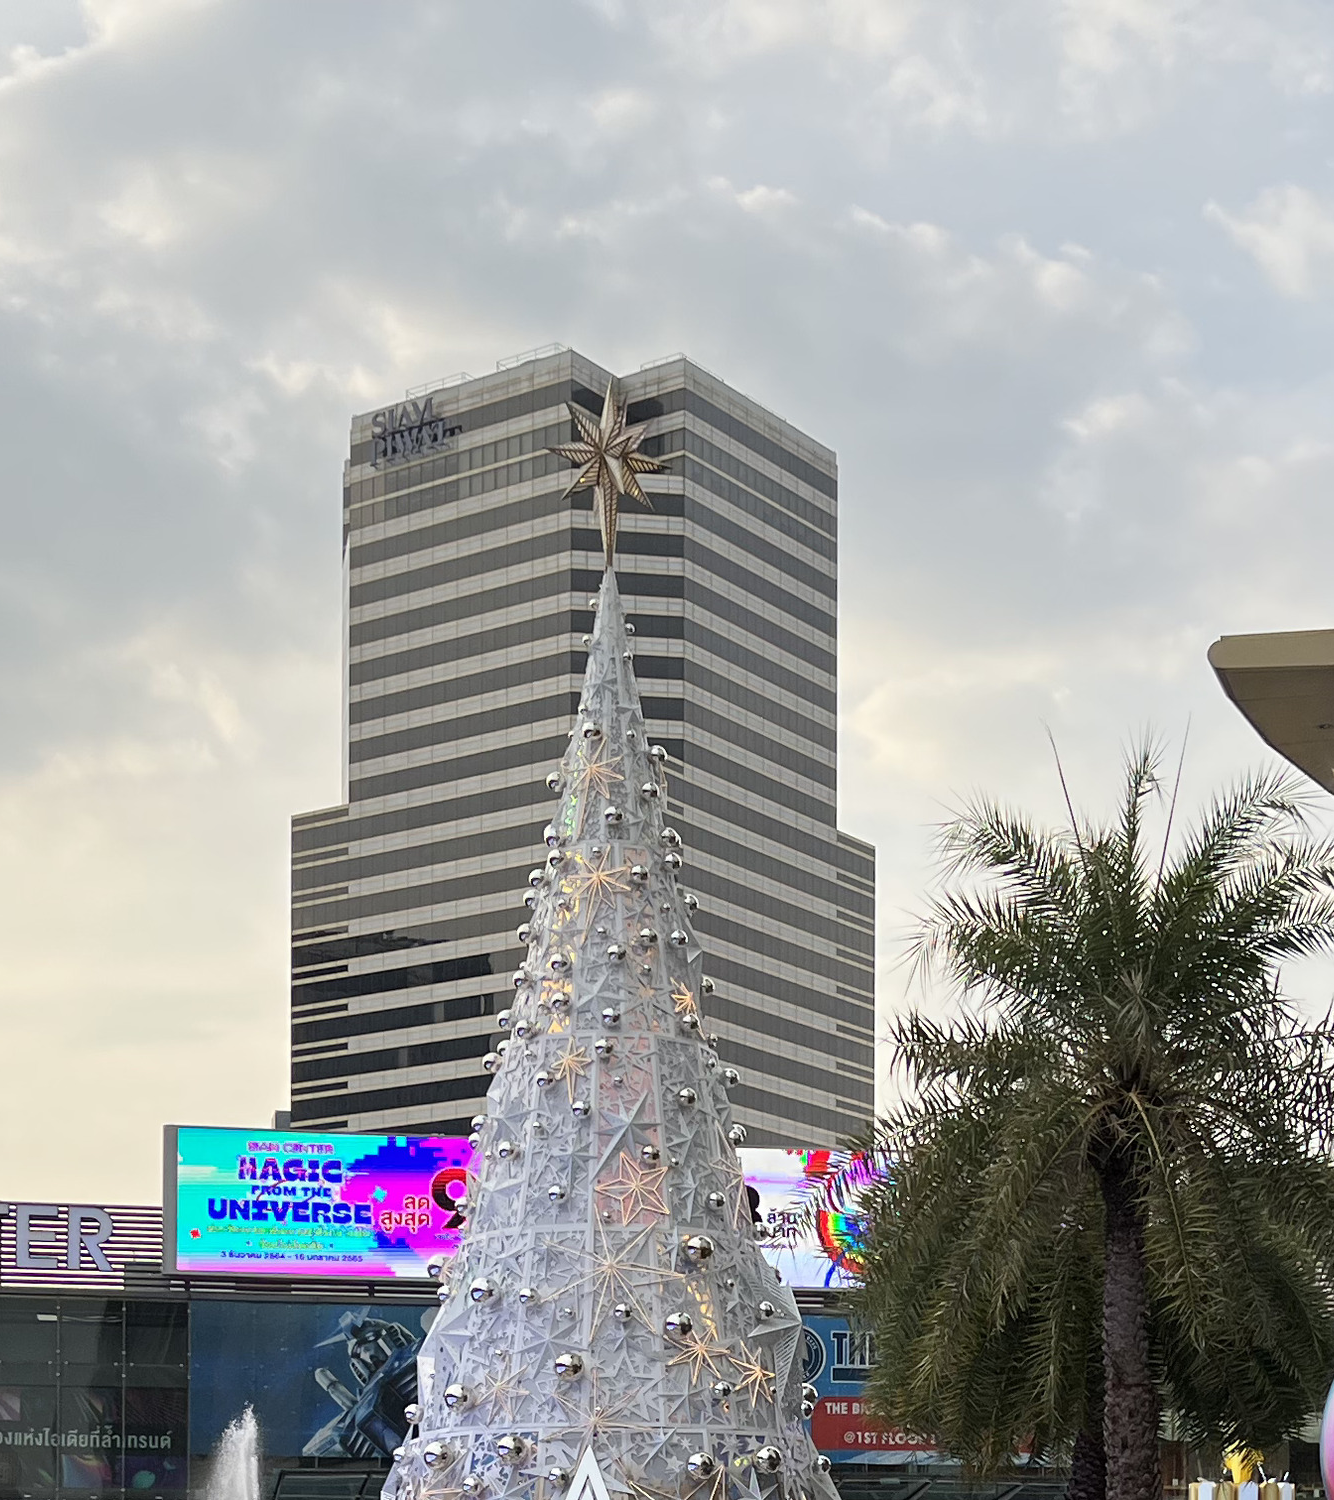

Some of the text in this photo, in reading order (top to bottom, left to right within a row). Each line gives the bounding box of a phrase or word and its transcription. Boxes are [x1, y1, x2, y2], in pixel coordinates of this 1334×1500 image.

[238, 1156, 343, 1183] MAGIC
[251, 1185, 332, 1198] FROM THE
[405, 1196, 430, 1210] ลด
[208, 1198, 372, 1225] UNIVERSE
[381, 1211, 430, 1233] สูงสุด
[825, 1402, 848, 1416] THE
[844, 1431, 878, 1445] @1ST
